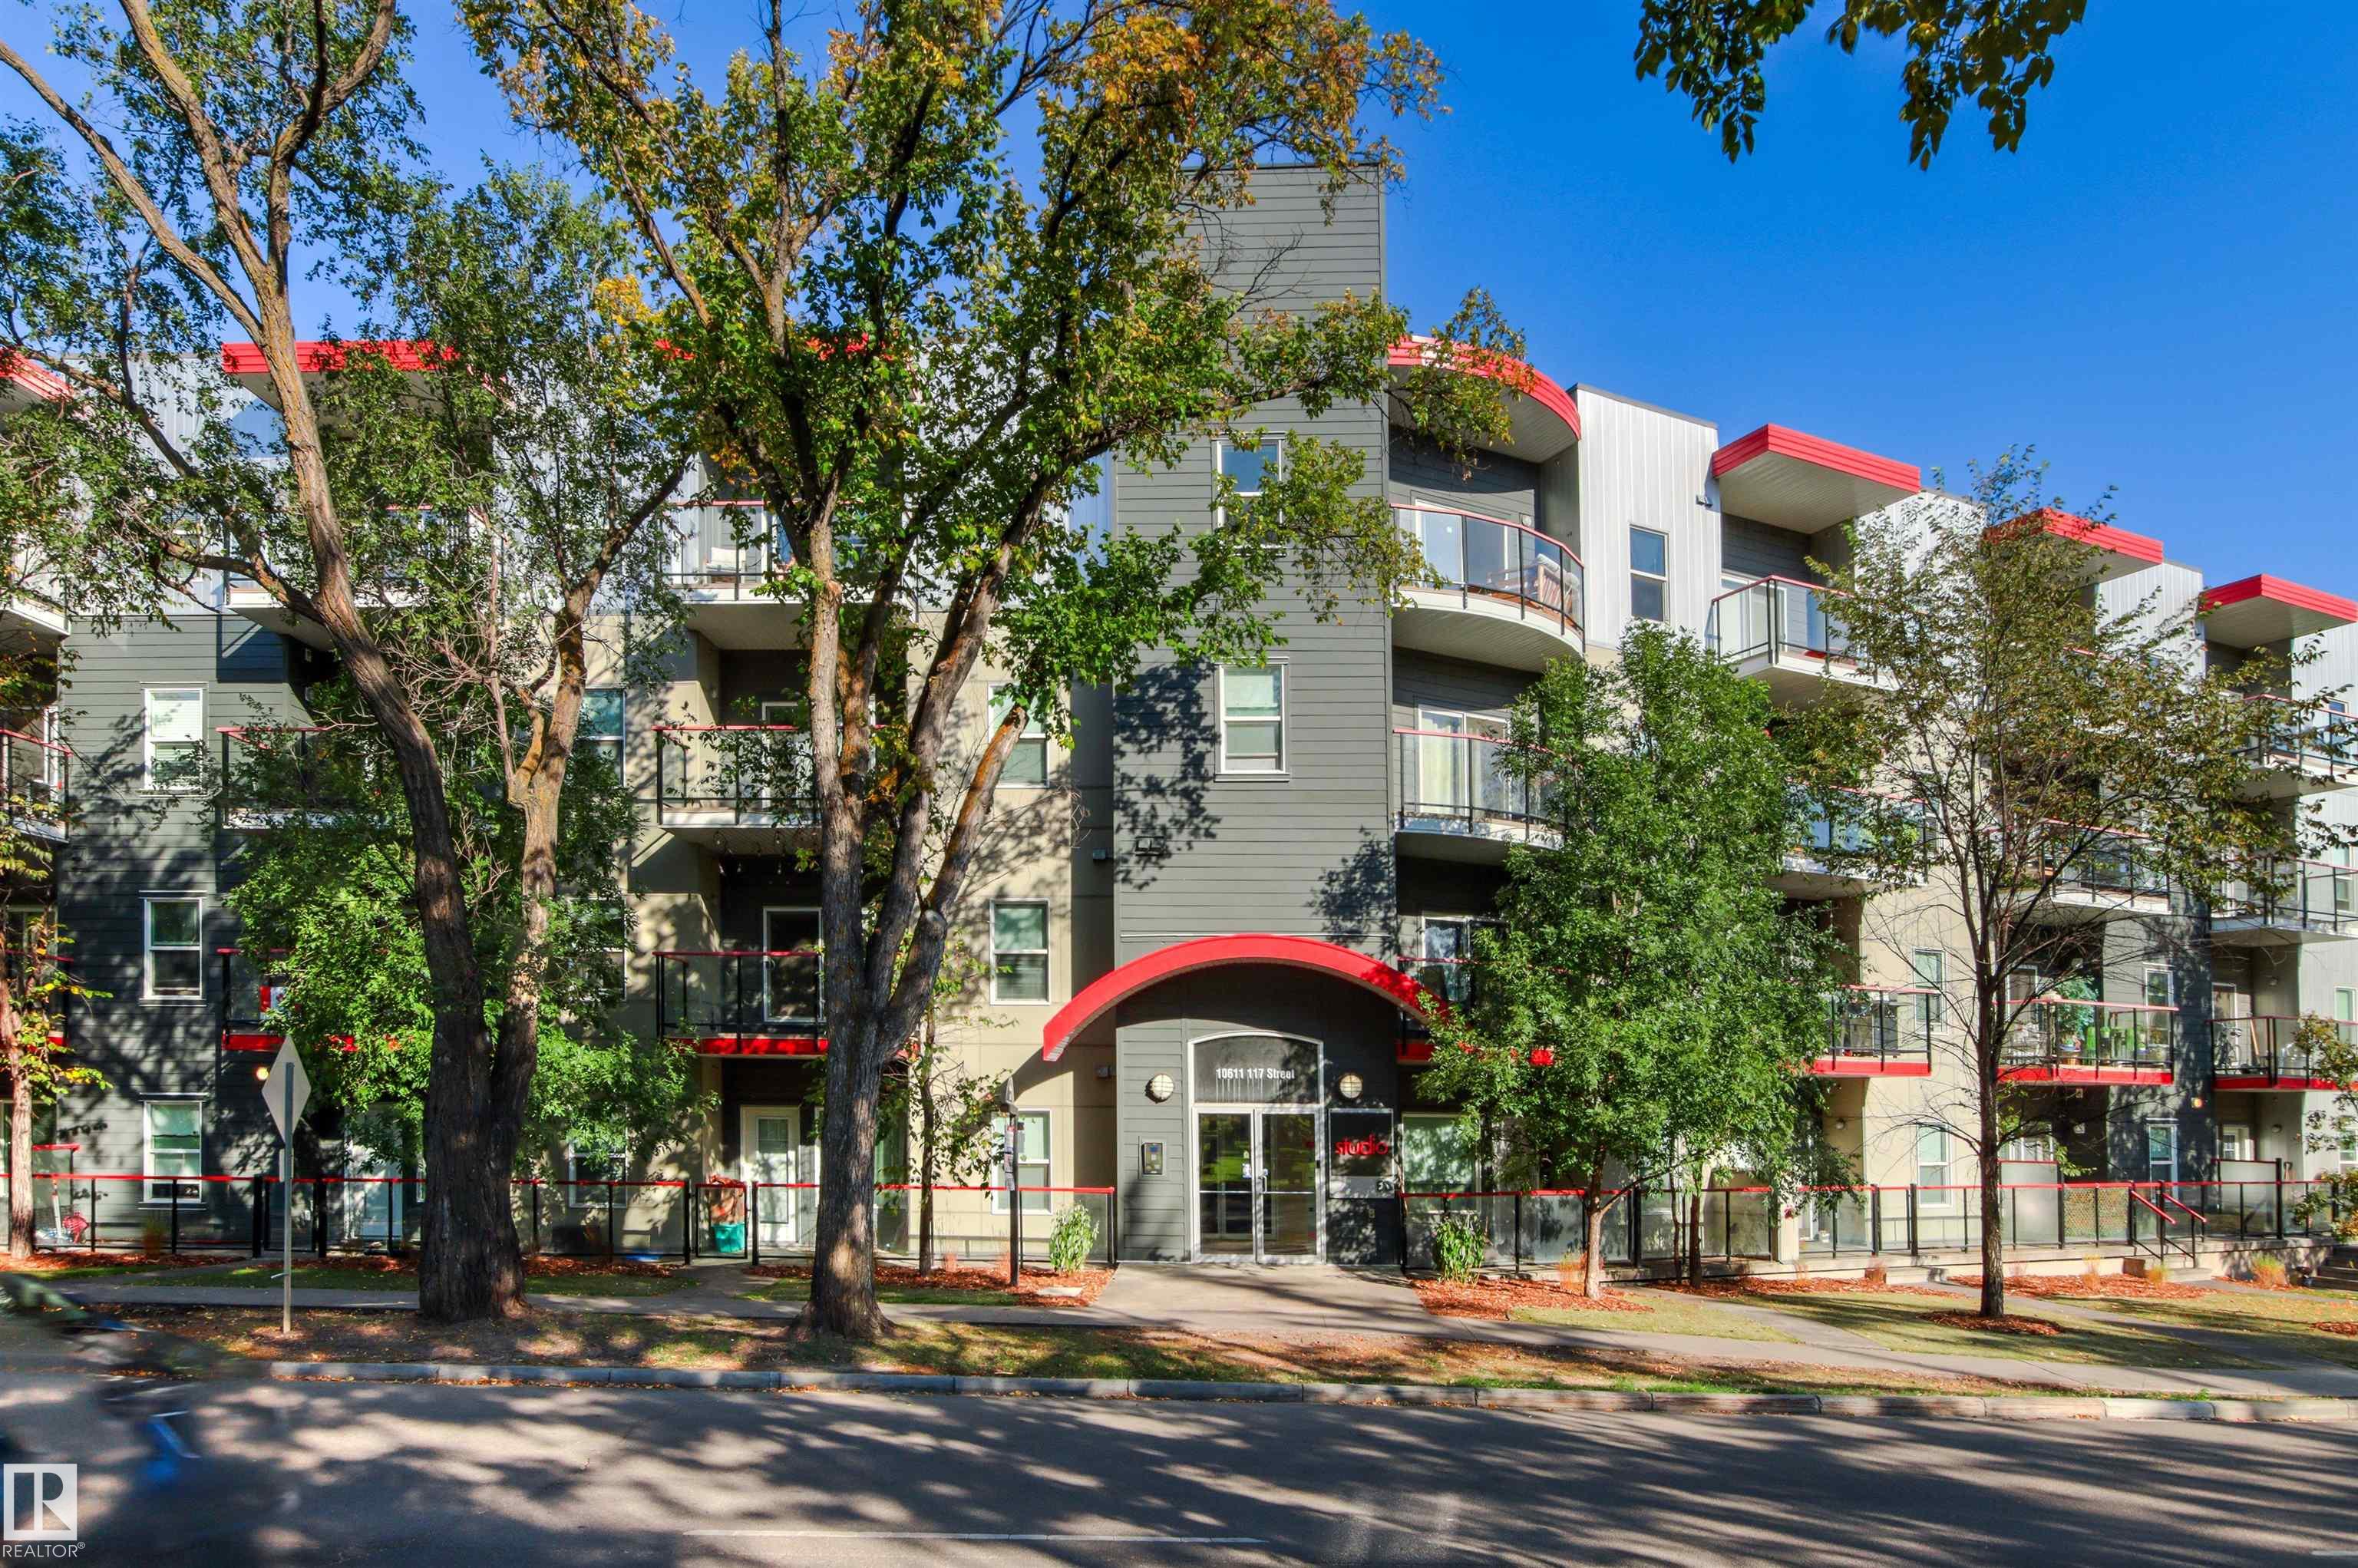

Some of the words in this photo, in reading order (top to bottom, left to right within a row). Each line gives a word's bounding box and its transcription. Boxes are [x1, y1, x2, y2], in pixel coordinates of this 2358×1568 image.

[1216, 1068, 1244, 1080] 10611
[1247, 1068, 1264, 1080] 117
[1267, 1068, 1295, 1080] Street
[1336, 1133, 1389, 1155] studio
